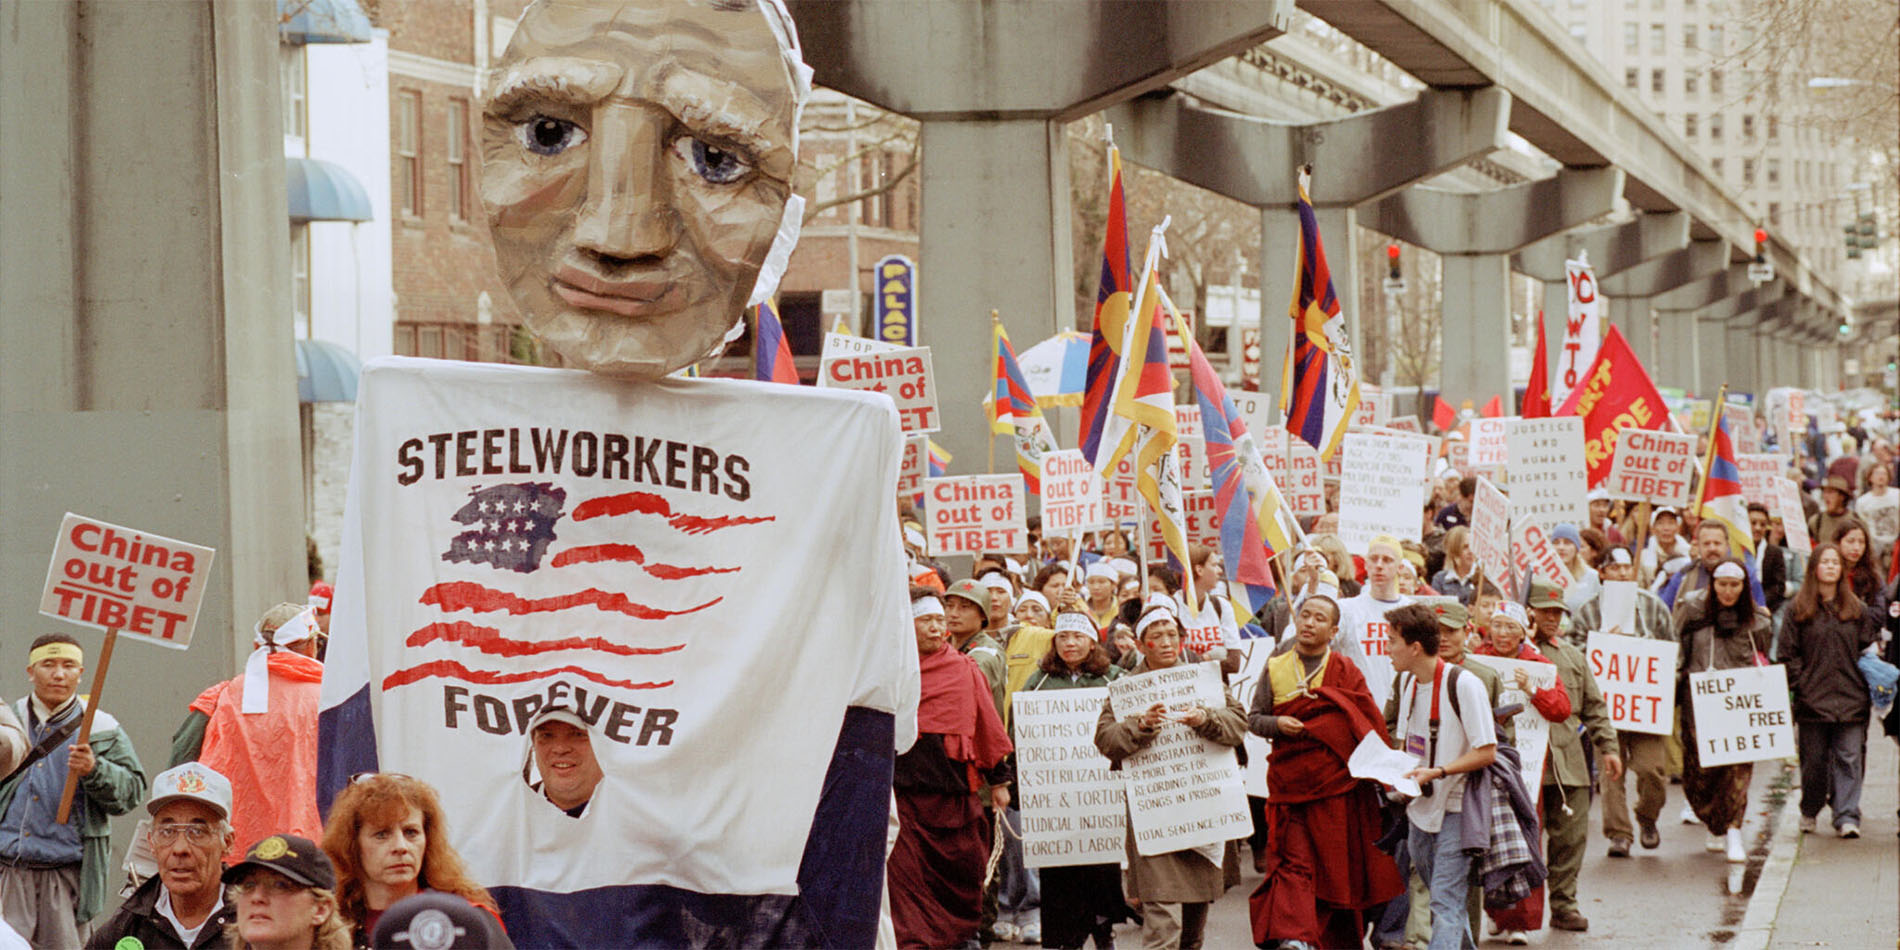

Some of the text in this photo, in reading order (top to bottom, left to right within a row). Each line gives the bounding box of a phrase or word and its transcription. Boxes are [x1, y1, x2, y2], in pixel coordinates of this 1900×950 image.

[882, 263, 908, 346] PALAC
[832, 338, 872, 353] STOP
[830, 354, 925, 382] China
[899, 376, 926, 400] of
[1513, 422, 1574, 435] JUSTICE
[1585, 396, 1653, 470] RADE
[1627, 432, 1690, 456] China
[397, 427, 751, 503] STEELWORKERS
[1262, 454, 1317, 472] Chna
[1623, 455, 1686, 475] out of
[1047, 479, 1075, 499] out
[1302, 472, 1317, 489] of
[1510, 470, 1585, 485] RIGHTS TO
[1619, 474, 1686, 500] TIBET
[933, 480, 1013, 505] China
[1535, 488, 1559, 497] ALL
[936, 499, 1014, 525] out of
[70, 522, 195, 574] China
[934, 529, 1019, 555] TIBET
[1525, 525, 1568, 591] China
[64, 556, 192, 604] out of
[52, 587, 188, 642] TIBET
[1367, 622, 1390, 639] FR
[1591, 649, 1660, 686] SAVE
[1696, 677, 1735, 698] HELP
[1016, 699, 1070, 718] TIBETAN
[1604, 691, 1662, 726] BET
[1724, 693, 1763, 713] SAVE
[1017, 720, 1091, 741] VICTIMS OF
[1748, 710, 1786, 729] FREE
[1175, 732, 1183, 743] A
[1707, 732, 1777, 756] TIBET
[1018, 743, 1068, 763] FORCED
[1129, 743, 1205, 769] DEMONSTRATION
[1140, 763, 1169, 781] MORE
[1170, 761, 1189, 777] YRS
[1193, 758, 1209, 772] FOR
[1134, 768, 1233, 798] RECORDING PATRIOTIC
[1022, 788, 1127, 811] RAPE & TORTUR
[1136, 787, 1222, 812] SONGS IN PRISON
[1022, 813, 1127, 835] JUDICIAL INJUSTIC
[1137, 826, 1165, 843] TOTAL
[1166, 818, 1214, 836] SENTENCE
[1024, 836, 1122, 858] FORCED LABOR
